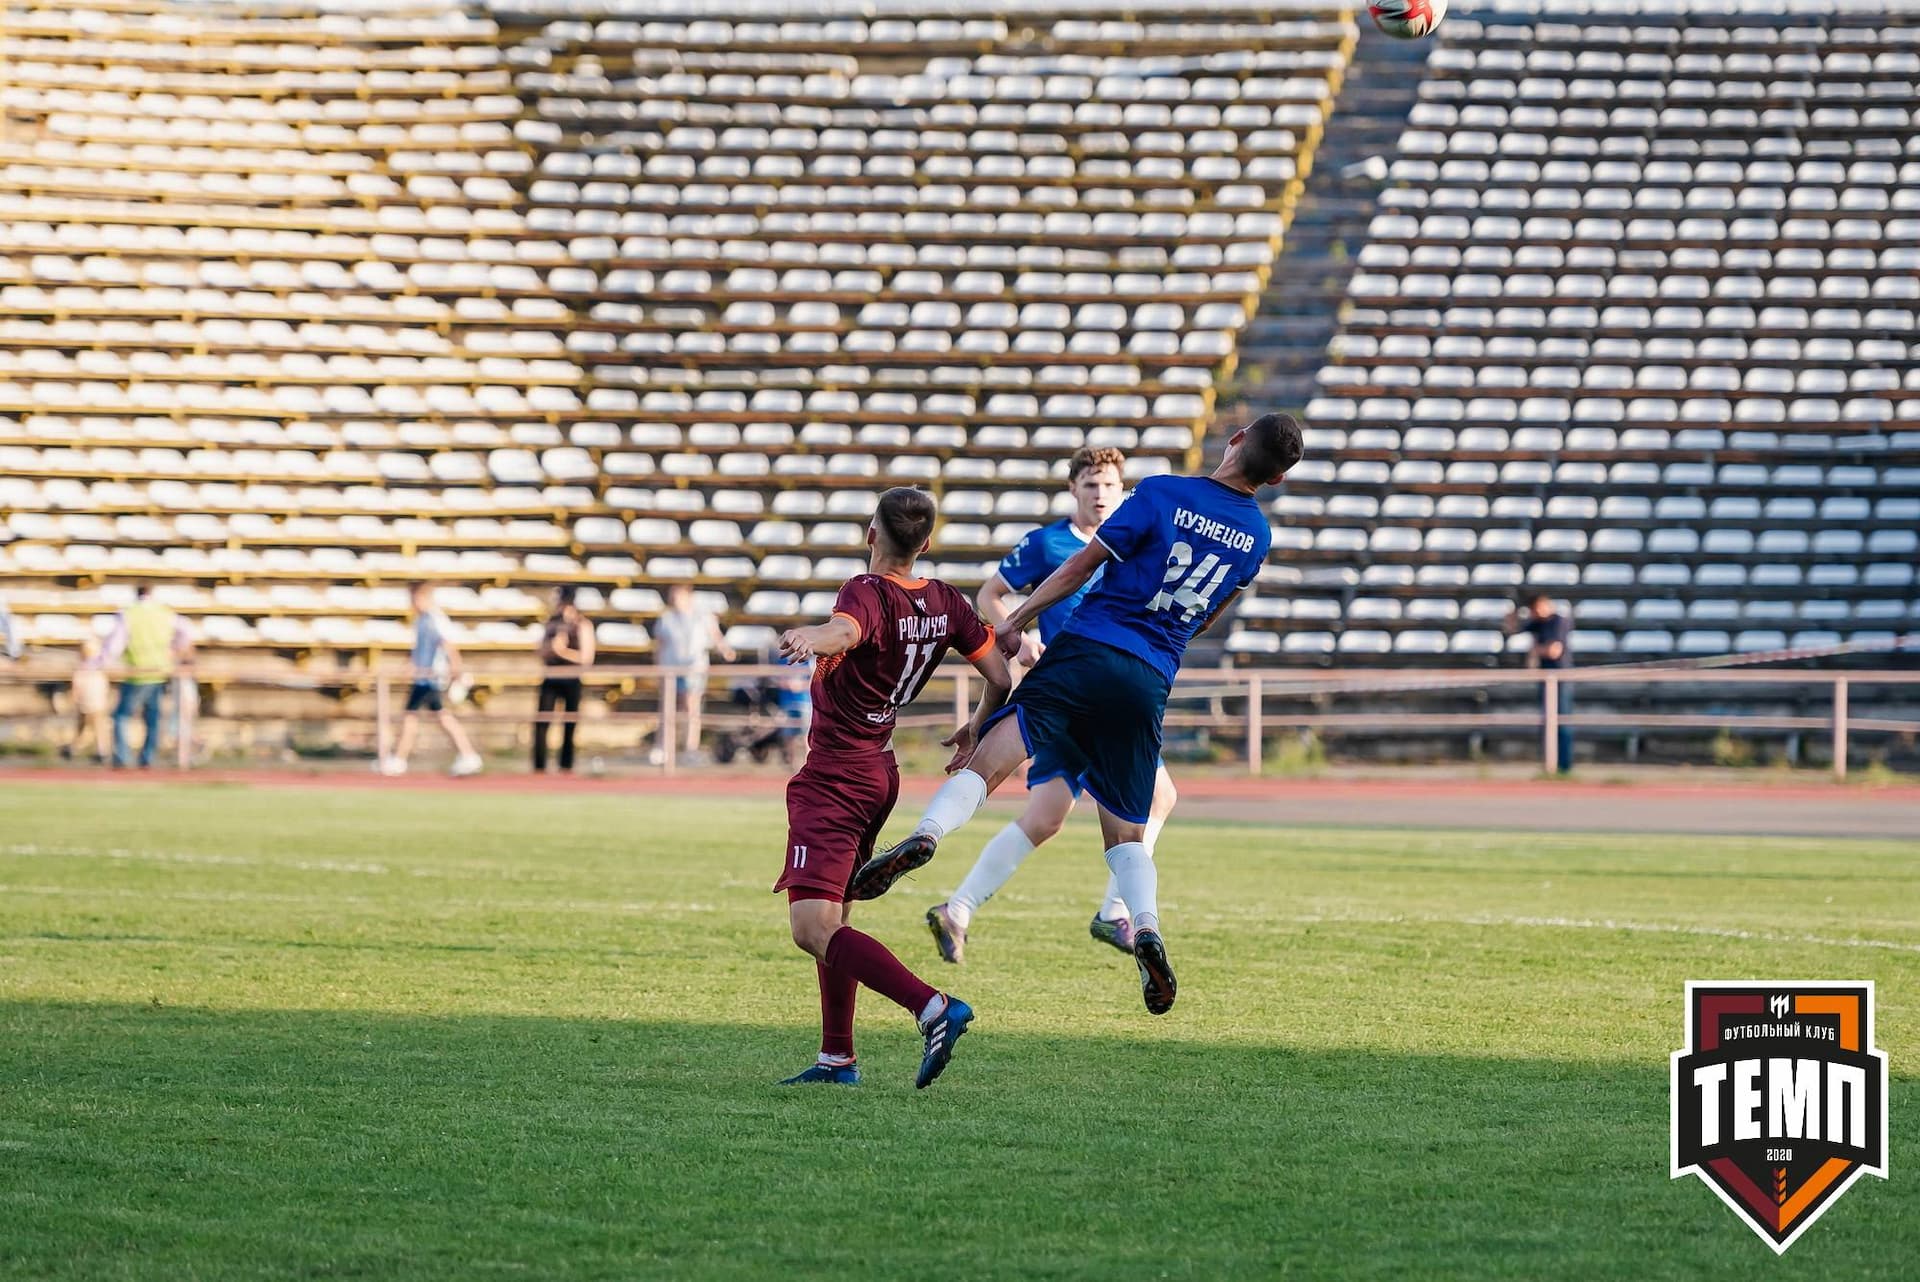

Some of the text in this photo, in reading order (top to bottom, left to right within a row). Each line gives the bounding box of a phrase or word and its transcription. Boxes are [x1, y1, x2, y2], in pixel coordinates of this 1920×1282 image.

[1173, 507, 1255, 553] КУЗНЕЦОВ
[1145, 541, 1233, 623] 24
[889, 641, 938, 706] 11
[793, 845, 808, 869] 11
